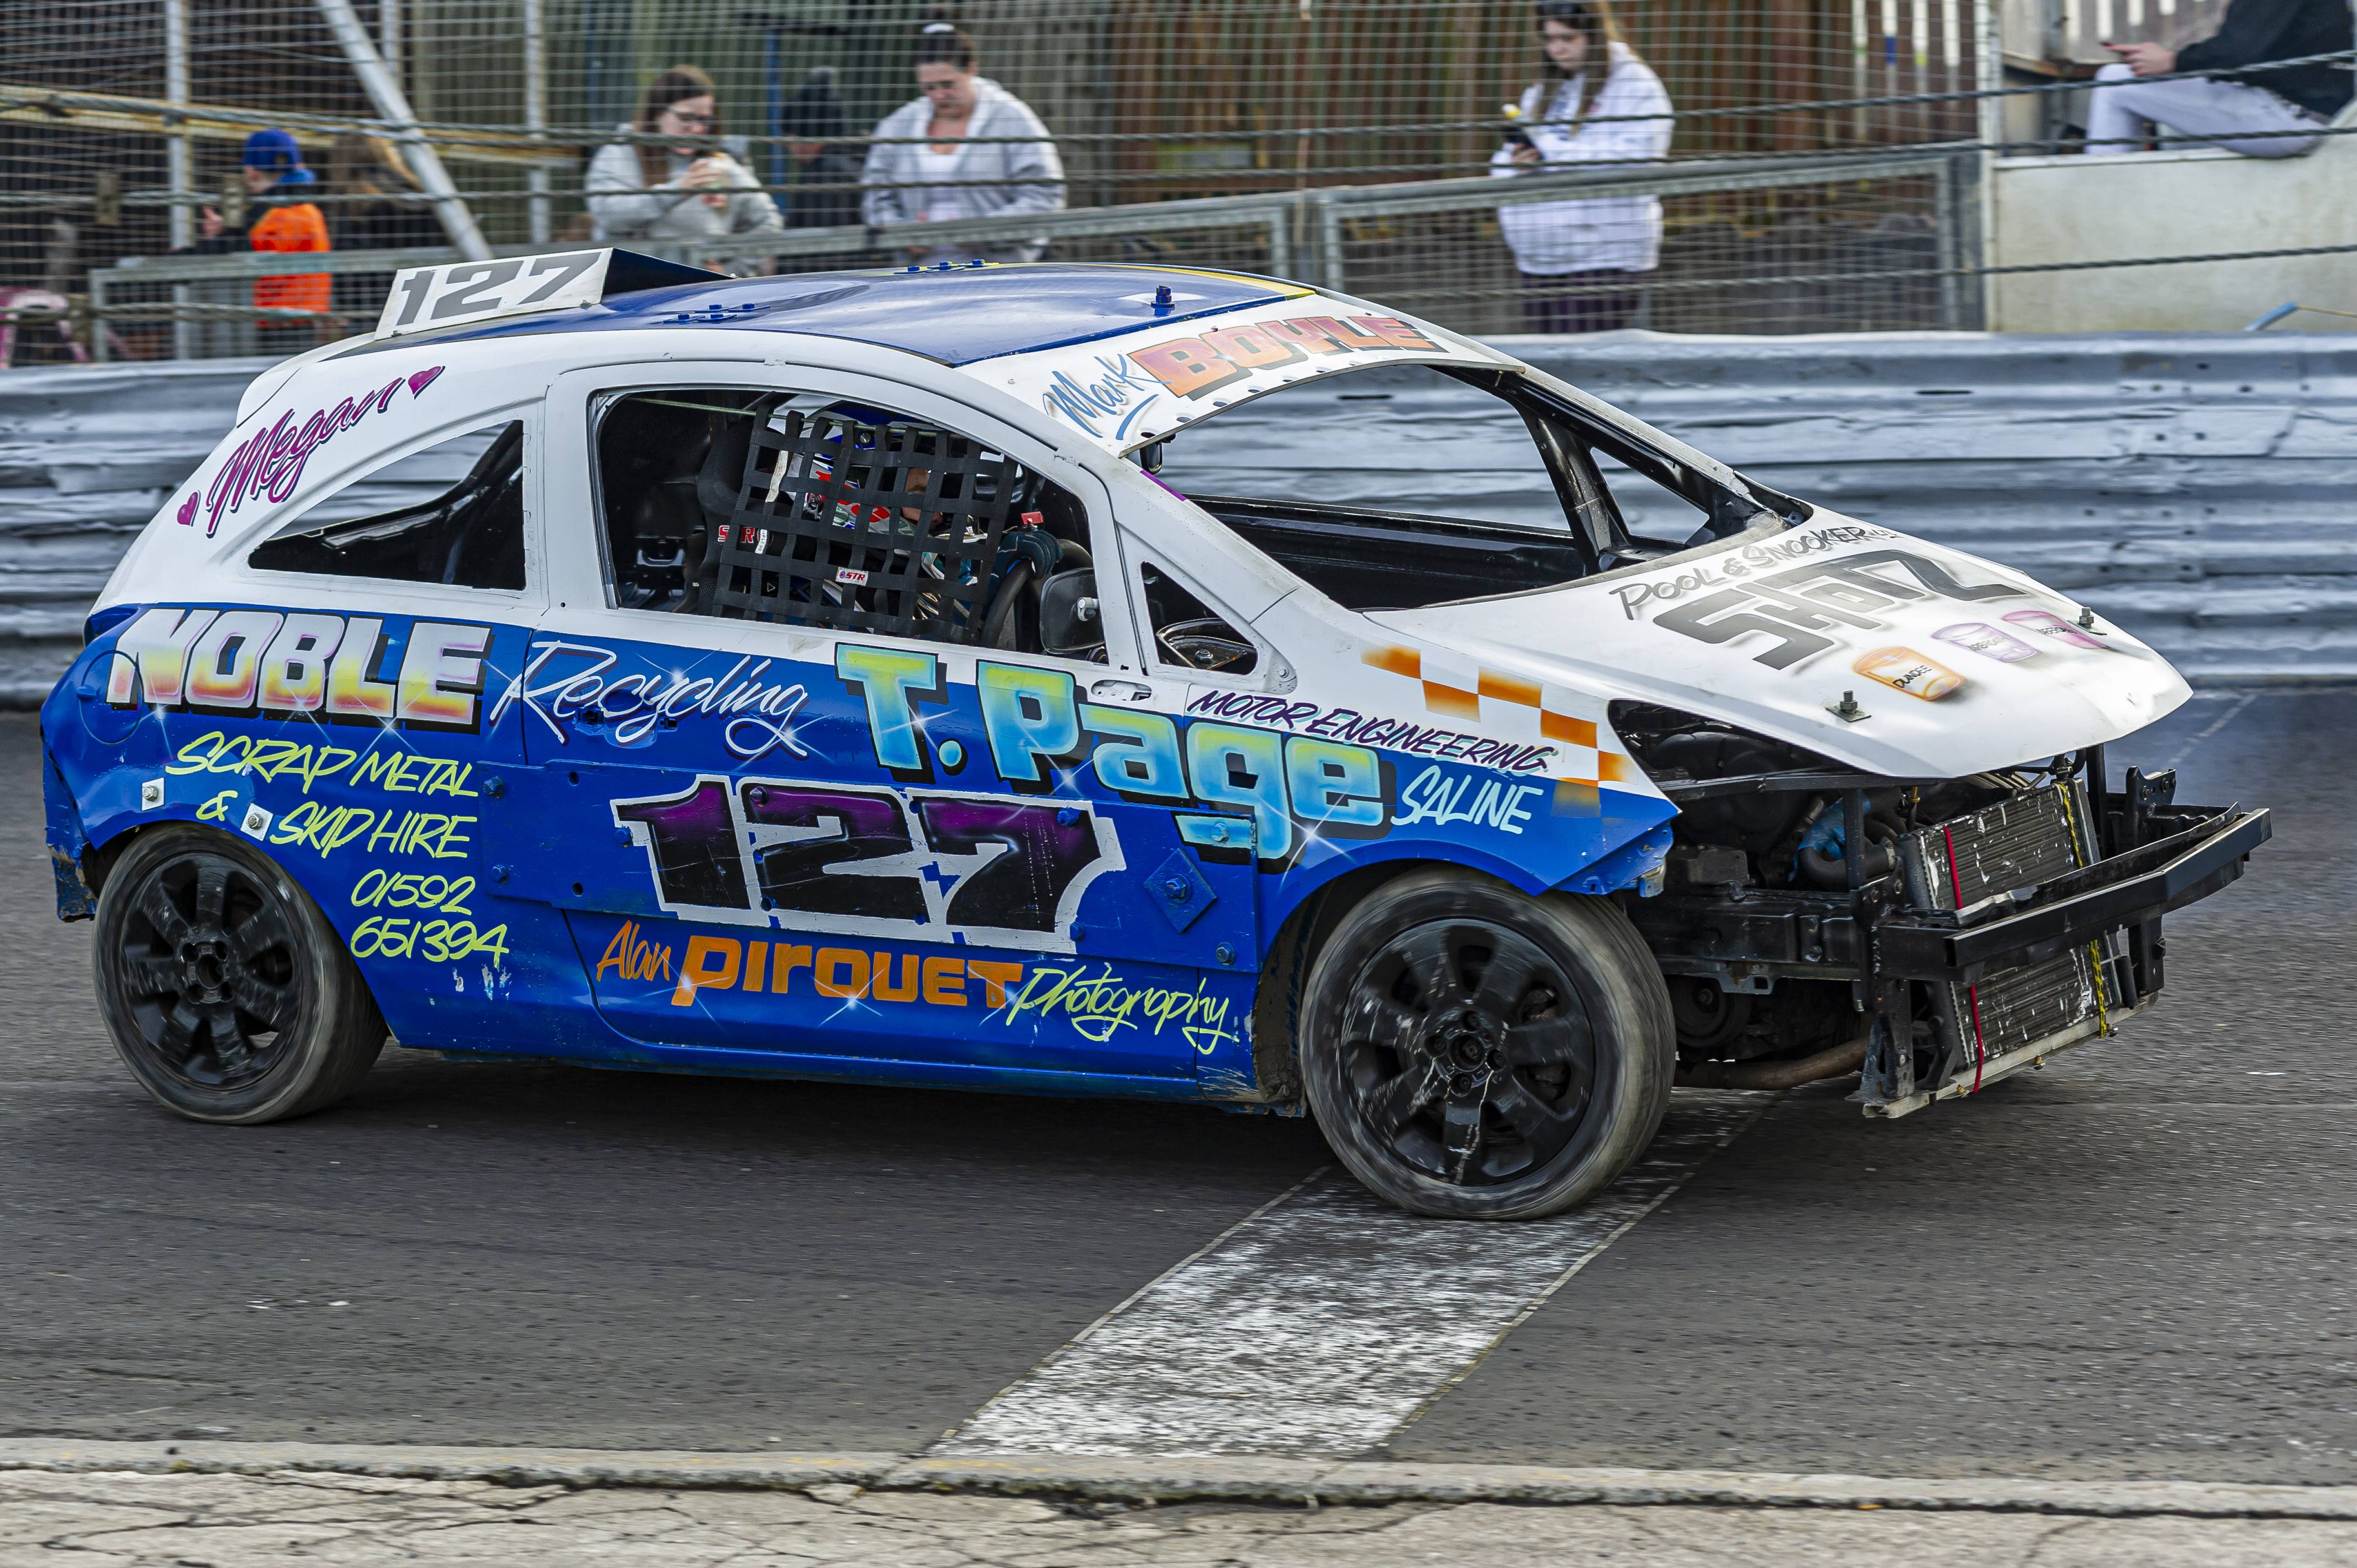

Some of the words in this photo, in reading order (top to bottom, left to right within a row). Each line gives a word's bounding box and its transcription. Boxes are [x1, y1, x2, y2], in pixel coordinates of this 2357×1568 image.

[397, 251, 601, 326] 127
[1043, 354, 1171, 439] Mark
[1127, 316, 1444, 400] BOYLE
[205, 376, 406, 538] Megan
[845, 571, 865, 581] STR
[1609, 568, 1726, 620] POOL
[1722, 558, 1748, 575] &
[1742, 526, 1874, 566] SNOOKER
[1654, 549, 2026, 670] SHOTZ
[106, 607, 495, 732] NOBLE
[490, 639, 809, 760] Recycling
[1892, 665, 1933, 689] DUNDEE
[165, 731, 356, 794] SCRAP
[349, 750, 478, 797] METAL
[835, 641, 966, 780] T.
[976, 659, 1391, 871] Page
[1187, 689, 1321, 730] MOTOR
[1310, 707, 1558, 776] ENGINEERING
[195, 790, 238, 822] &
[270, 801, 374, 859] SKIP
[367, 809, 477, 859] HIRE
[1391, 765, 1544, 834] SALINE
[351, 868, 476, 915] 01592
[610, 773, 1127, 955] 127
[350, 916, 510, 964] 651394
[596, 919, 672, 982] Alan
[1006, 964, 1239, 1053] Photography
